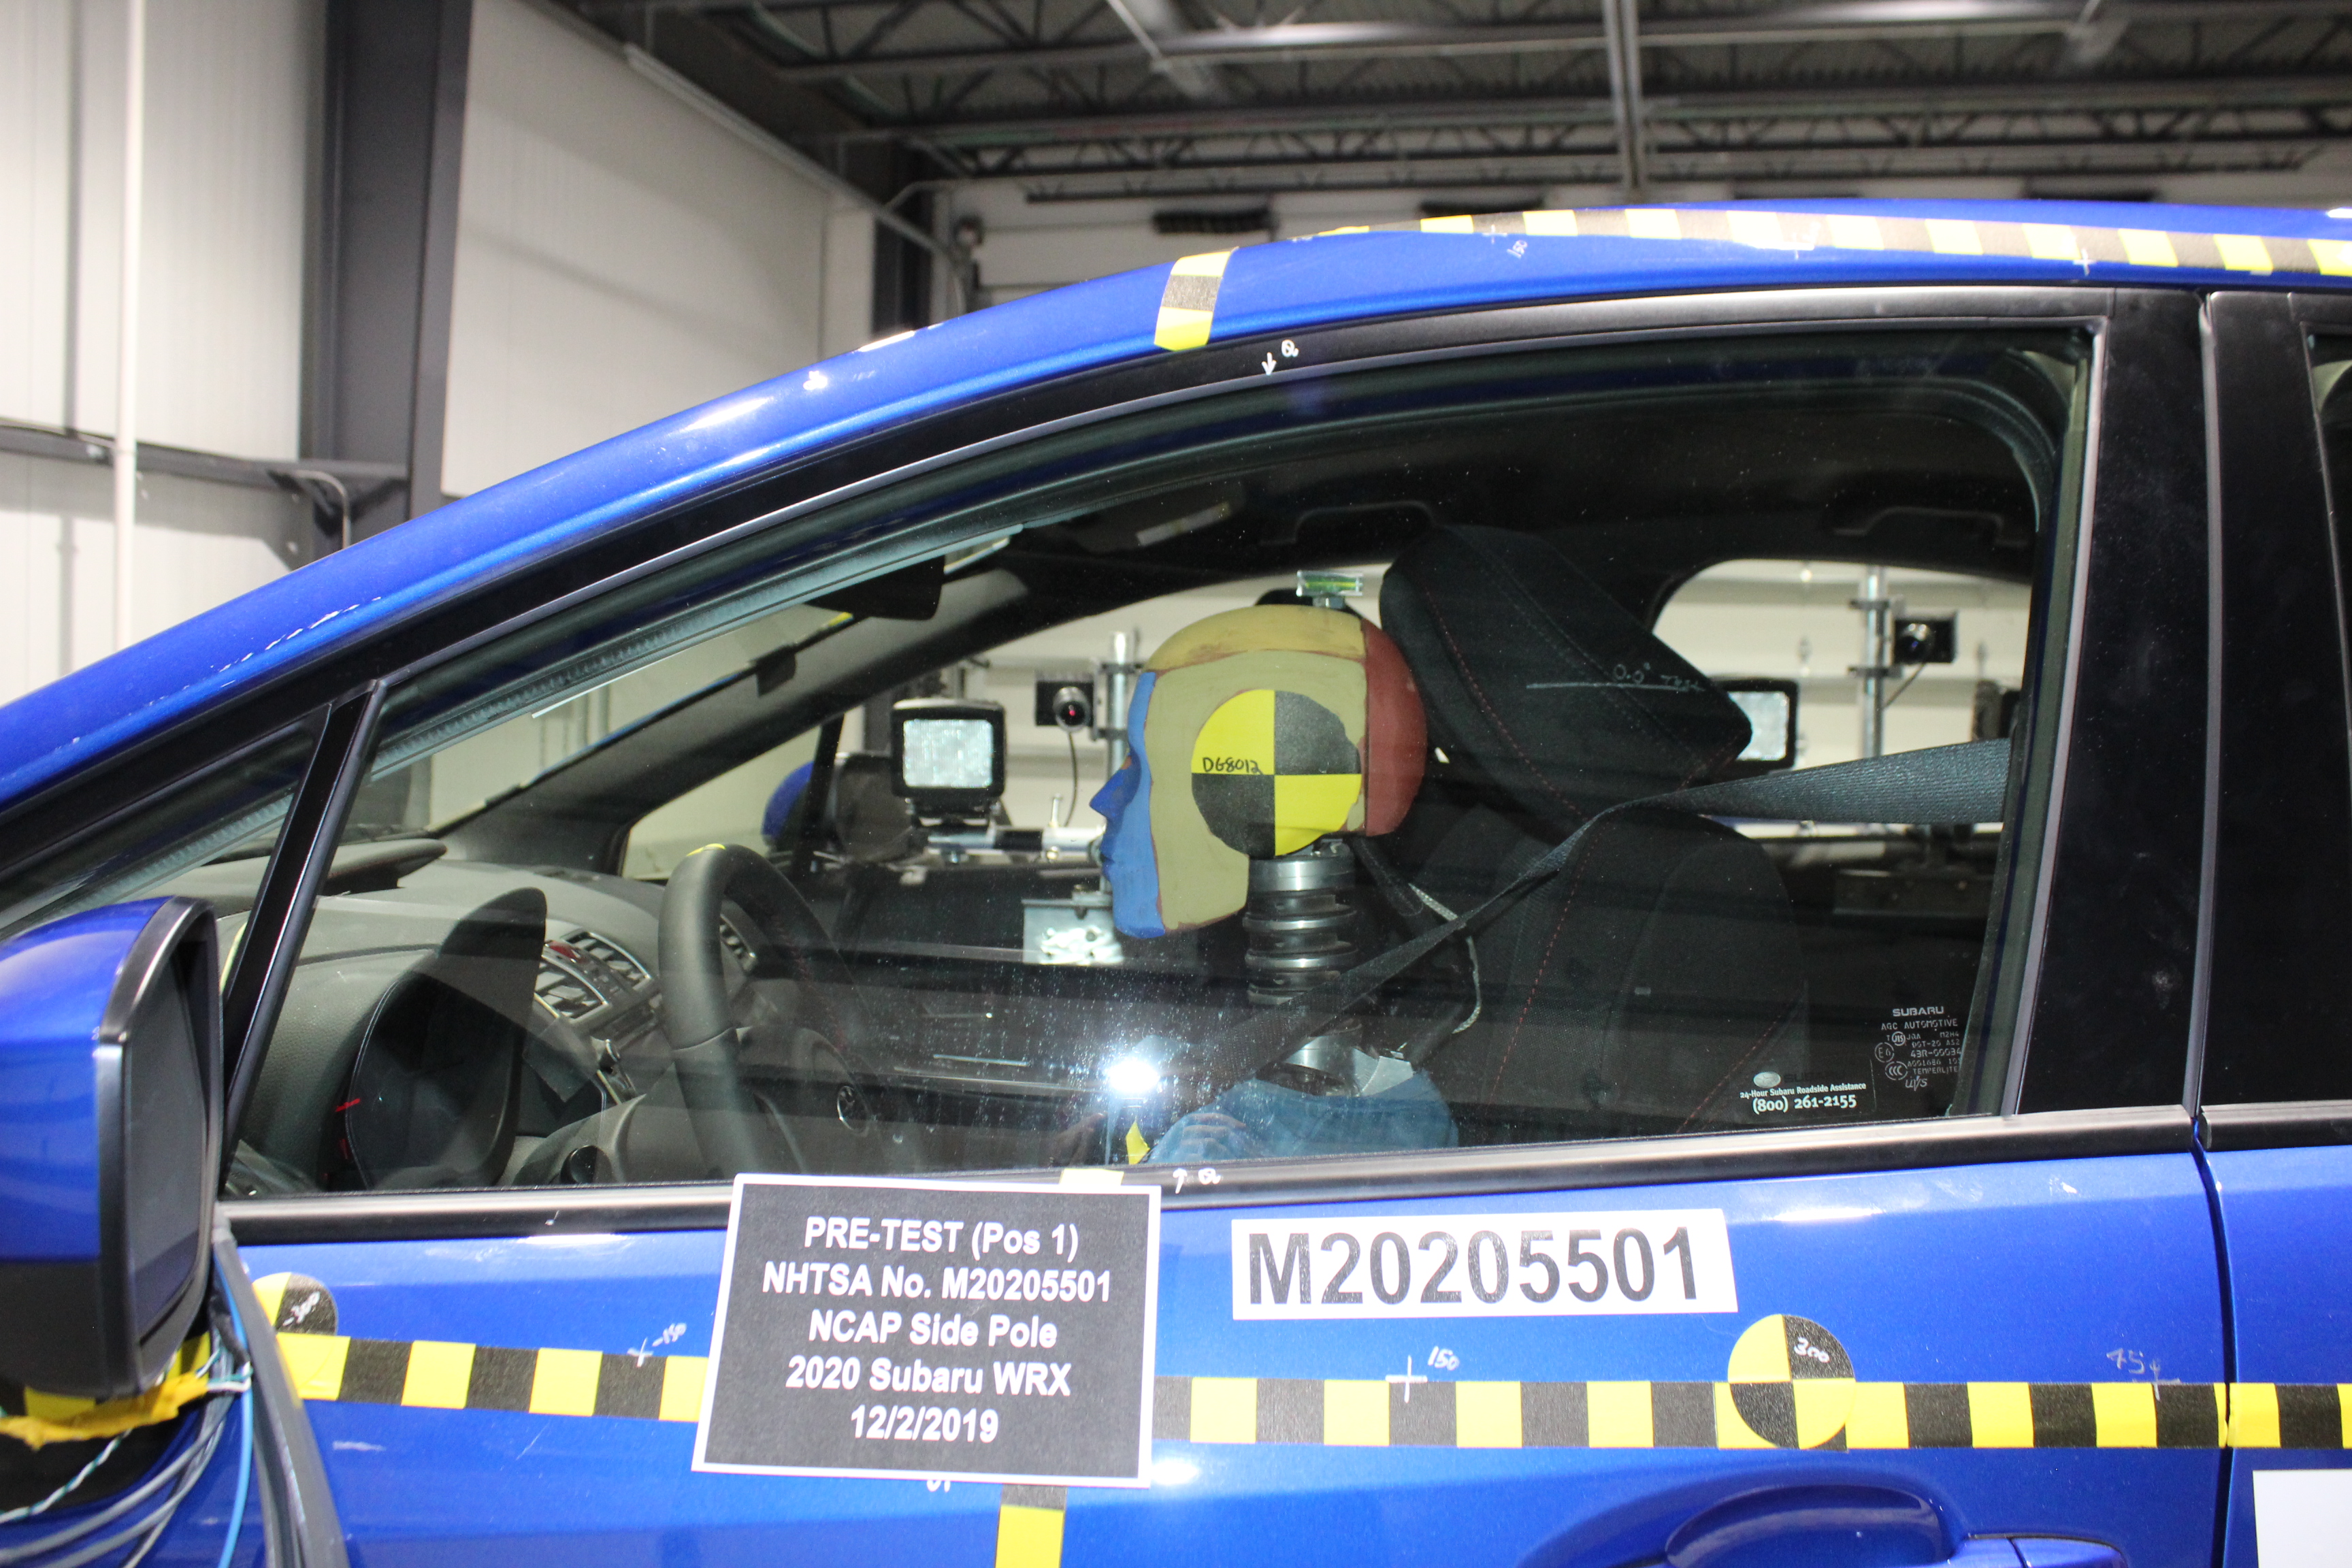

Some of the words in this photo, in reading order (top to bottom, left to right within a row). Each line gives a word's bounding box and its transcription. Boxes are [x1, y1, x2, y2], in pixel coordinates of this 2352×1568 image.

[1202, 756, 1263, 774] DG8012
[1880, 1022, 1898, 1030] AGC
[1904, 1018, 1958, 1029] AUTOMOTIVE
[1892, 1006, 1944, 1017] SUBARU
[1740, 1090, 1768, 1100] 24-Hour
[1769, 1088, 1795, 1097] Subaru
[1797, 1085, 1829, 1094] Roadside
[1830, 1083, 1866, 1092] Assistance
[1752, 1096, 1788, 1115] (800)
[1794, 1094, 1857, 1109] 261-2155
[804, 1215, 964, 1254] PRE-TEST
[971, 1221, 1041, 1261] (Pos
[1051, 1222, 1079, 1262] 1)
[1249, 1226, 1697, 1305] M20205501
[762, 1261, 872, 1297] NHTSA
[881, 1266, 932, 1298] No.
[942, 1267, 1110, 1303] M20205501
[808, 1309, 902, 1344] NCAP
[909, 1313, 978, 1346] Side
[988, 1315, 1058, 1348] Pole
[1427, 1345, 1461, 1371] 150
[785, 1356, 861, 1390] 2020
[869, 1358, 983, 1394] Subaru
[993, 1362, 1071, 1396] WRX
[851, 1403, 998, 1443] 12/2/2019
